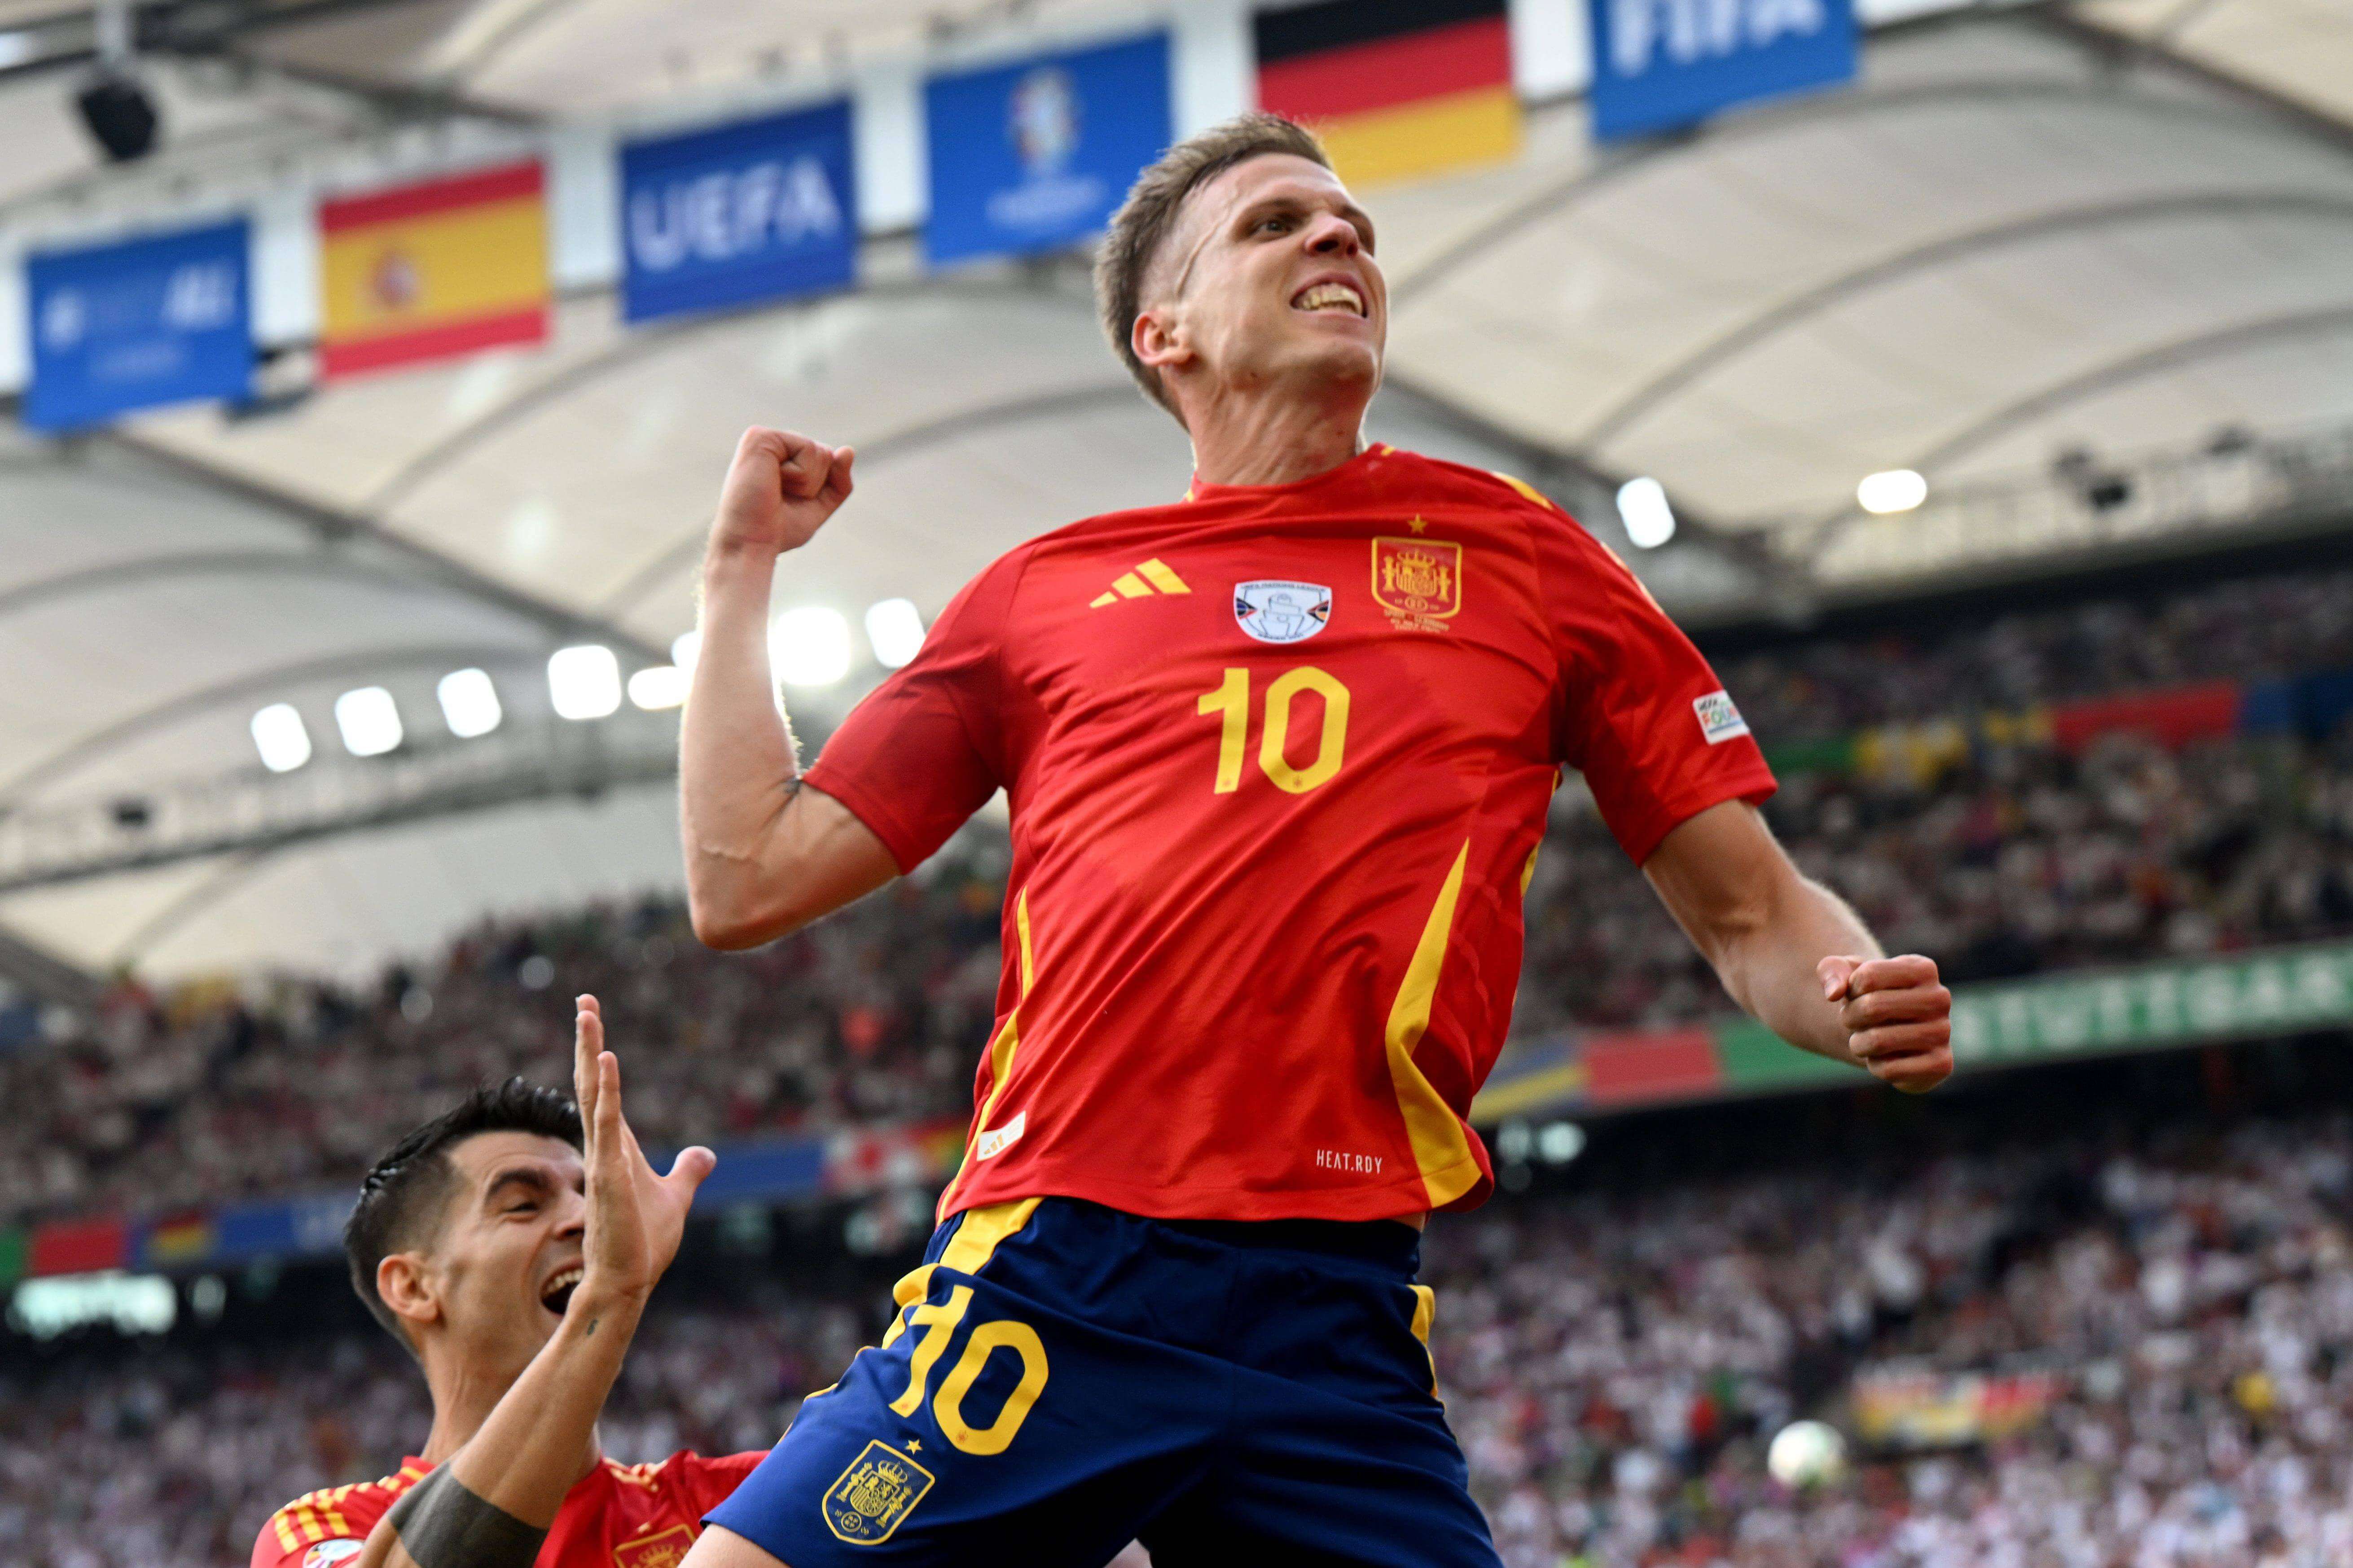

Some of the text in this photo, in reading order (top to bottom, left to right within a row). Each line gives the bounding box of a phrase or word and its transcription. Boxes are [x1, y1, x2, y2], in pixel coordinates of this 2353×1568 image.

[630, 156, 841, 269] UEFA
[1198, 666, 1350, 794] 10
[1951, 952, 2353, 1058] STUTTGAR
[889, 1284, 1049, 1455] 10
